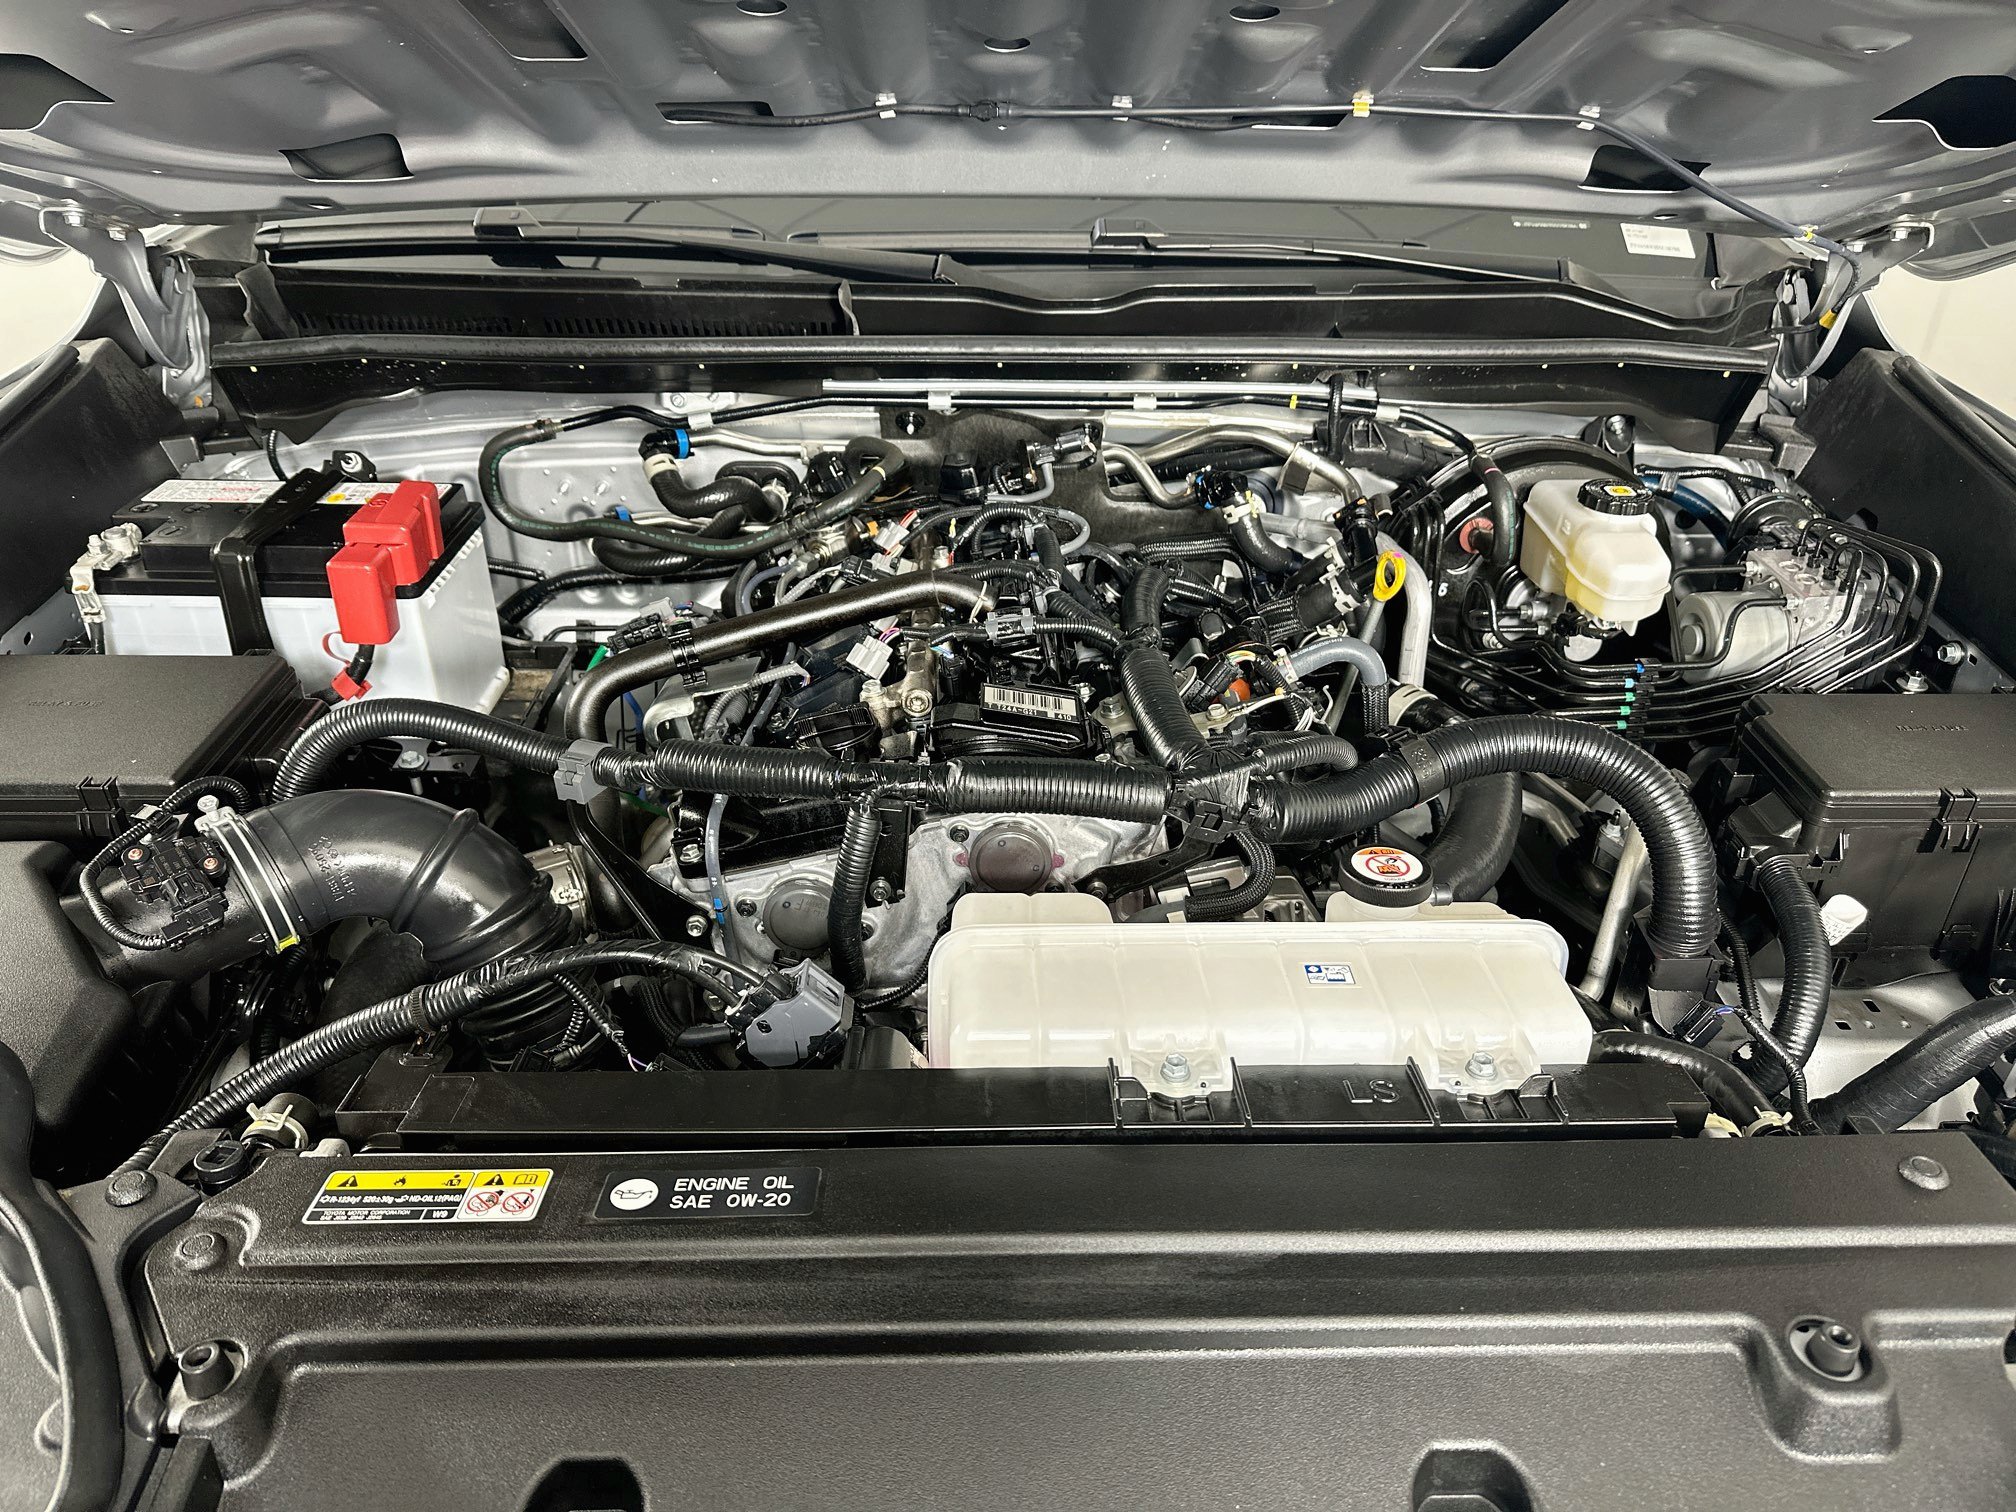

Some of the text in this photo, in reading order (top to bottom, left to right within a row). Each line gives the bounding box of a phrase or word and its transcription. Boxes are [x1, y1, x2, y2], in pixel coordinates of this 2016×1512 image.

[1342, 1078, 1400, 1104] LS
[673, 1175, 795, 1192] ENGINE OIL
[669, 1192, 791, 1209] SAE 0W-20
